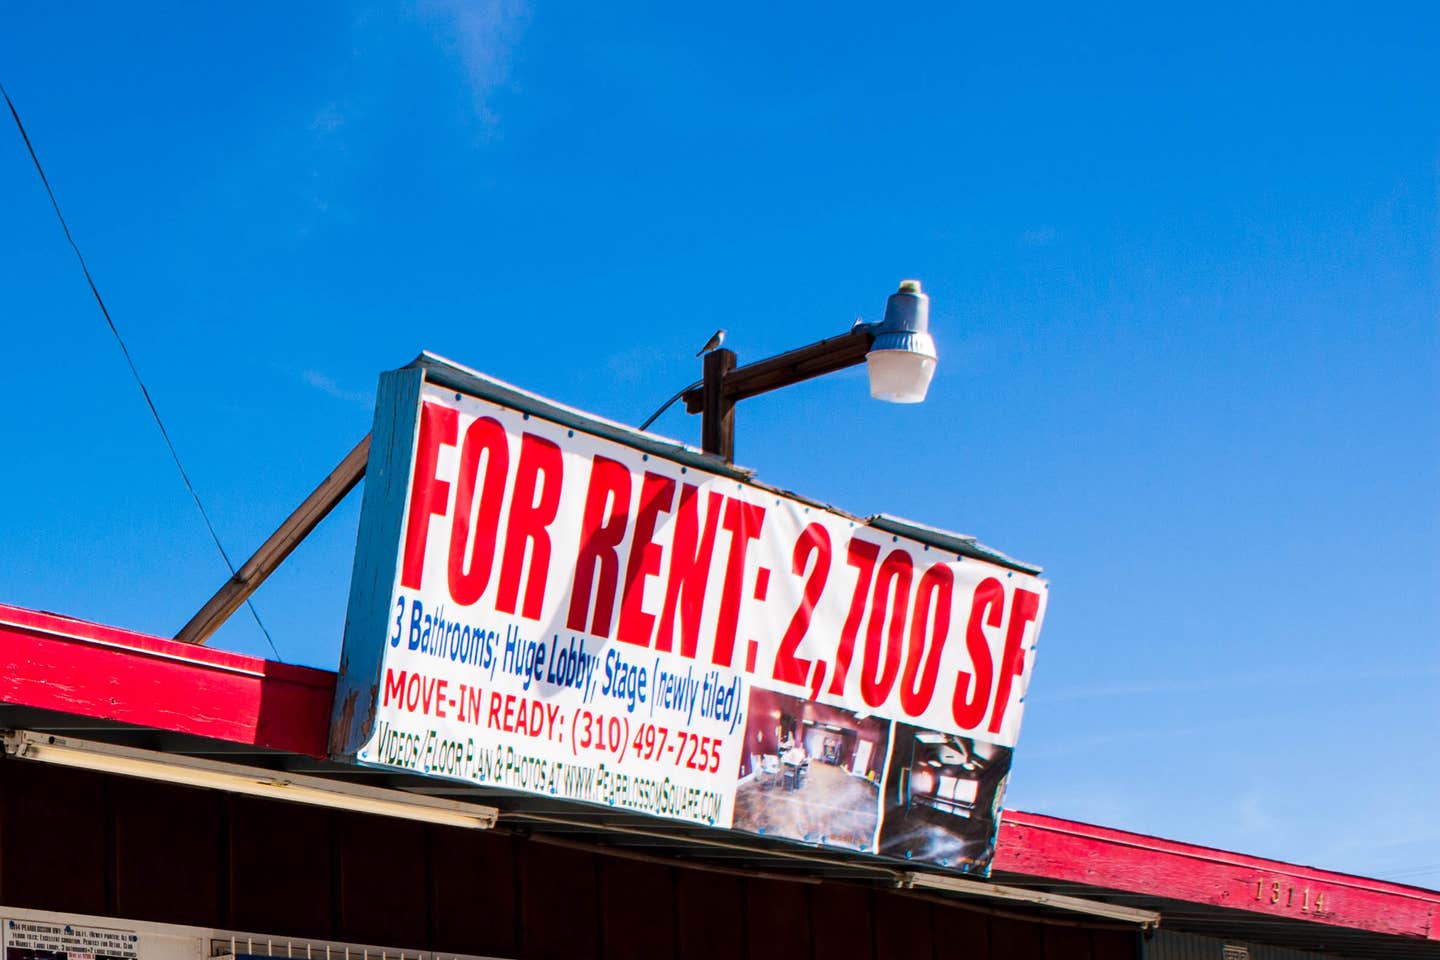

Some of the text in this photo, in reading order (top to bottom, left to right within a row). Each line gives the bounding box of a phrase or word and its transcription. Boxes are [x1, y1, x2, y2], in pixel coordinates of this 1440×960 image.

[400, 401, 1041, 734] FOR RENT: 2,700 SF
[390, 595, 742, 735] 3 Bathrooms; Huge Lobby; Stage (newly tiled).
[383, 668, 722, 774] MOVE-IN READY: (310) 497-7255
[494, 744, 504, 782] &
[1254, 877, 1324, 913] 13114
